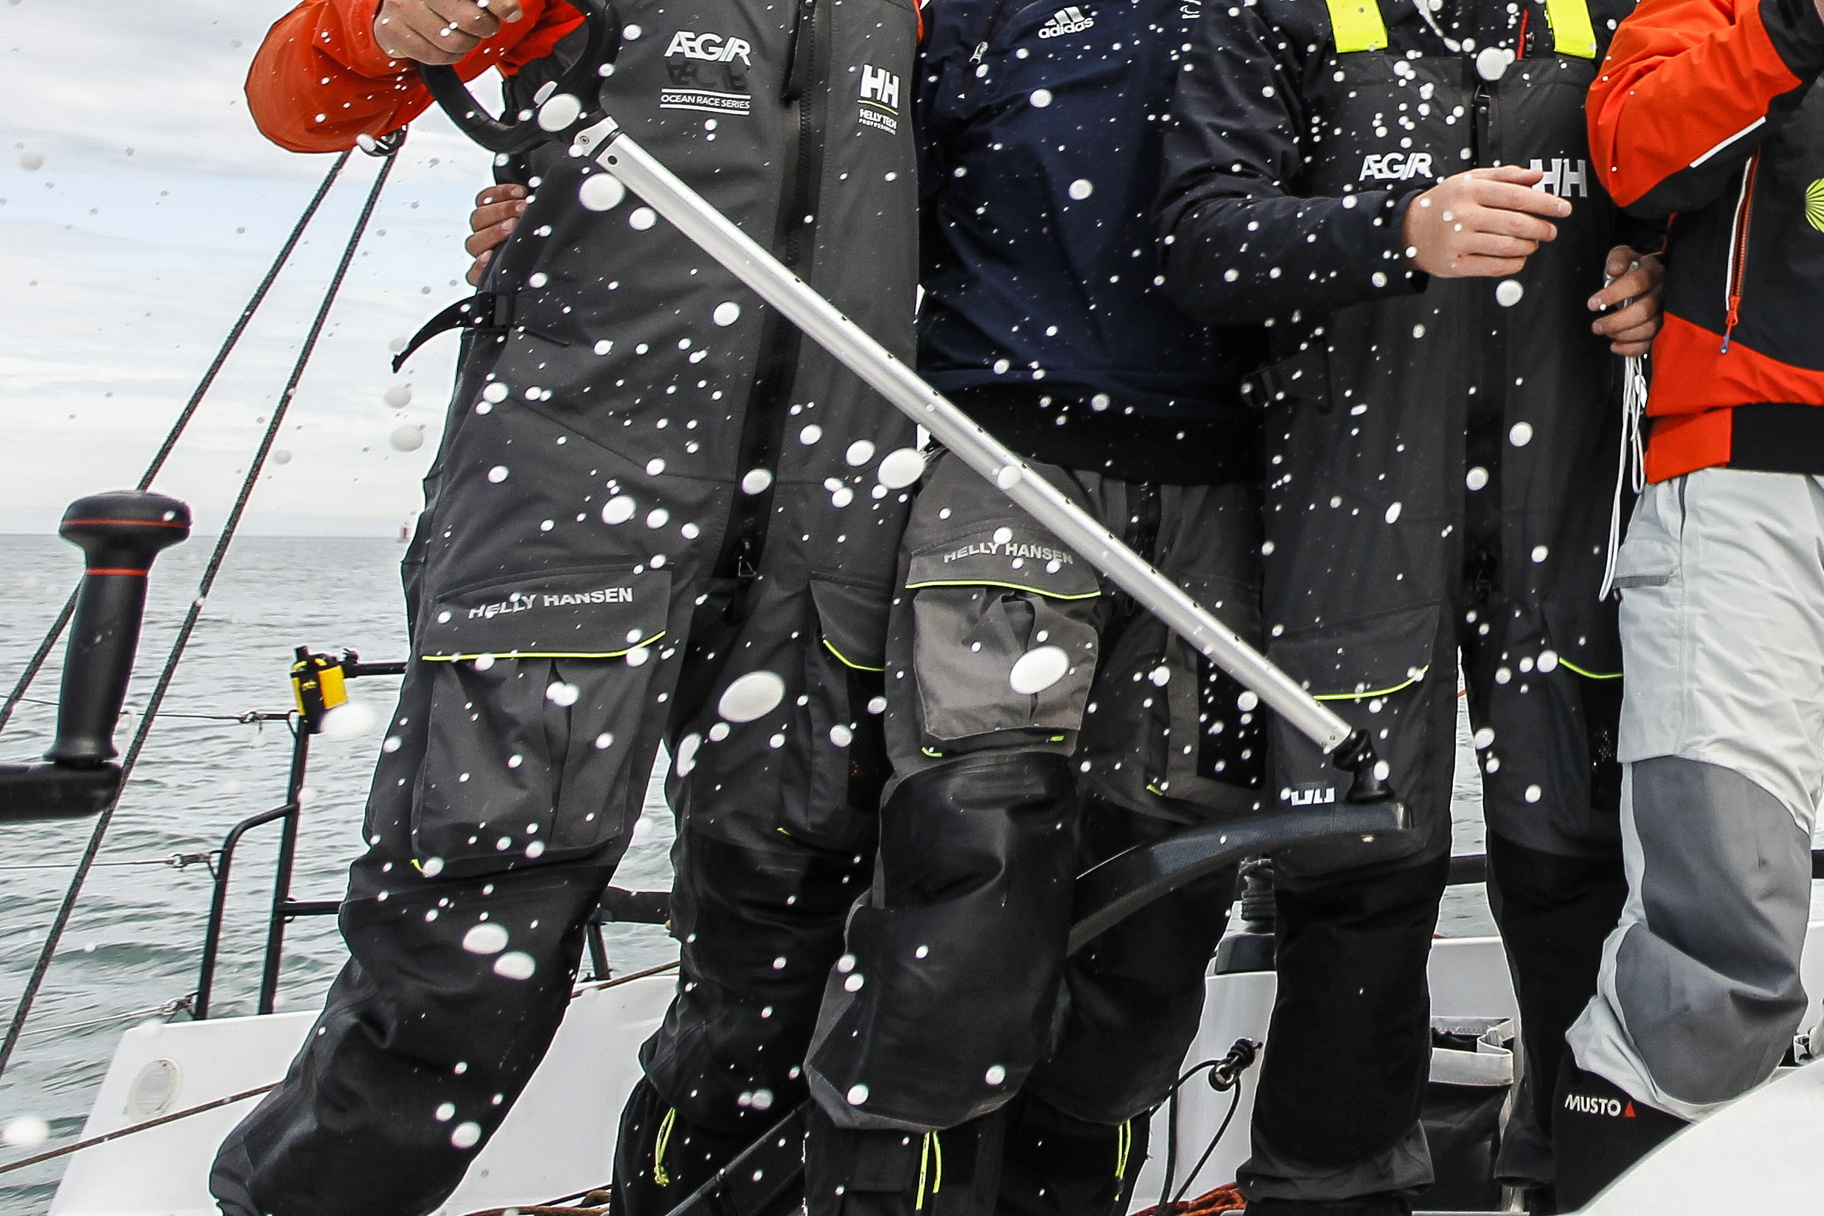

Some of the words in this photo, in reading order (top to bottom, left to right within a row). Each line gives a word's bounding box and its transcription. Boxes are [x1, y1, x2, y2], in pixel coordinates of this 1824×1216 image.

[1038, 17, 1095, 39] adidas
[860, 64, 900, 109] HH
[661, 95, 696, 104] OCEAN
[696, 96, 720, 107] RACE
[720, 99, 751, 110] SERIES
[1530, 158, 1588, 197] HH
[943, 542, 999, 563] HELLY
[1005, 543, 1074, 565] HANSEN
[468, 593, 537, 620] HELLY
[543, 587, 633, 607] HANSEN
[1564, 1094, 1622, 1117] MUSTO
